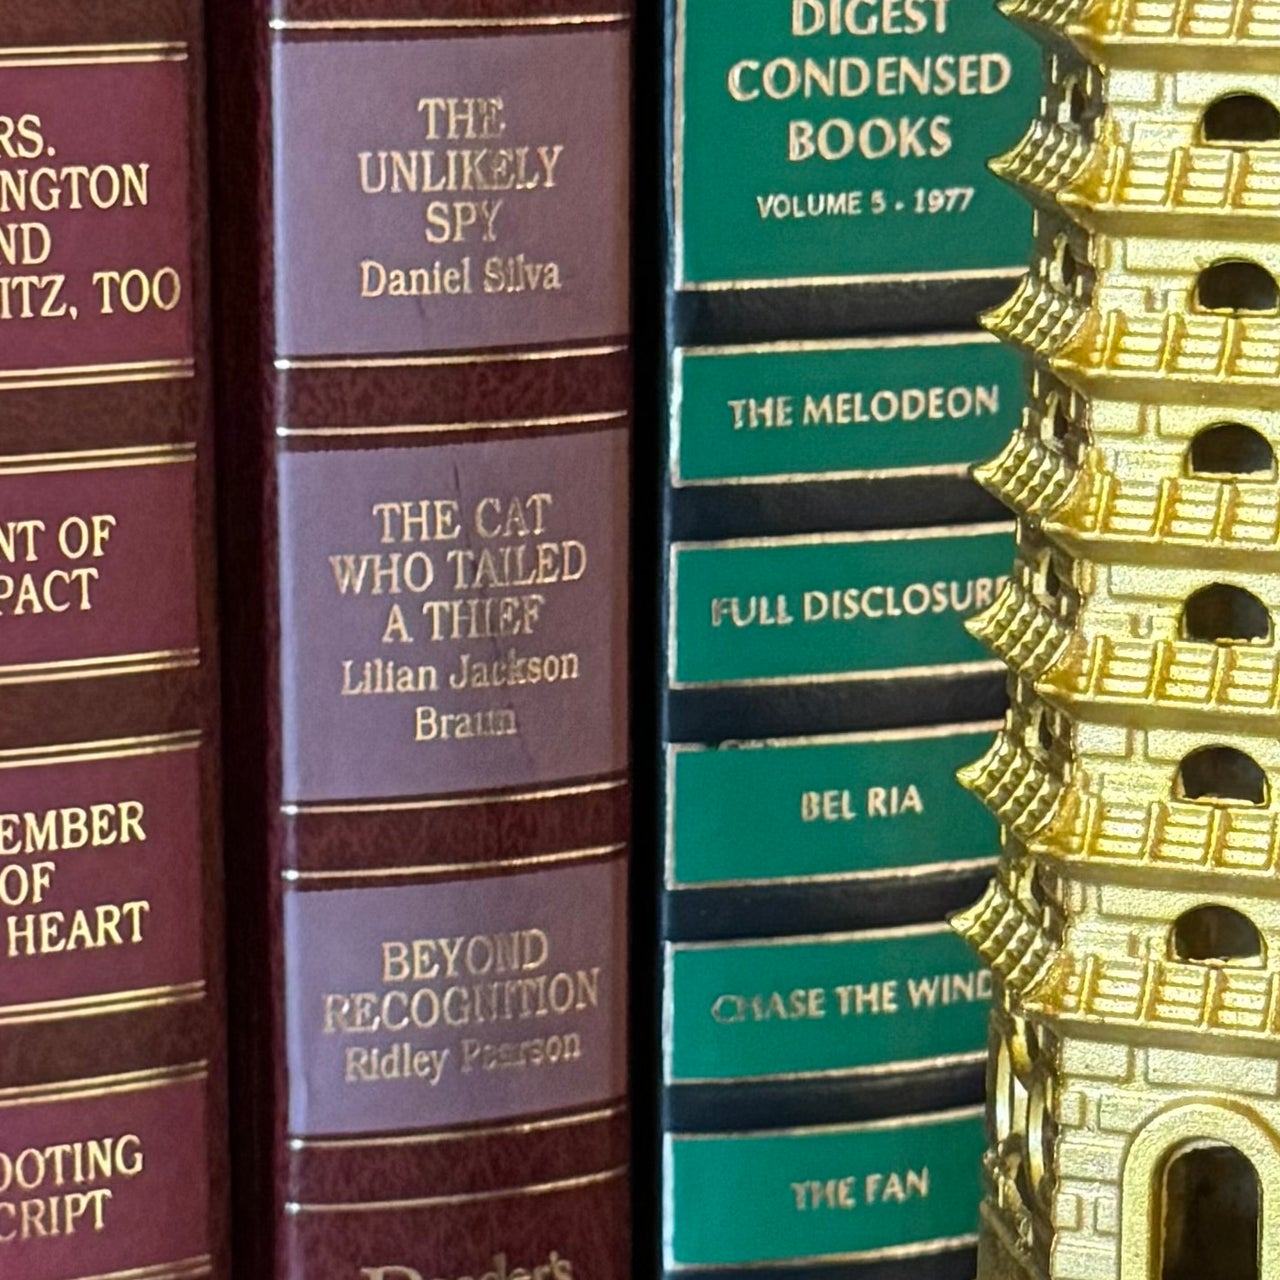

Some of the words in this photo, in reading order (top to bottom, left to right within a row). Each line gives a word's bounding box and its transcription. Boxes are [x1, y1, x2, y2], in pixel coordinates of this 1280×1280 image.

[727, 53, 1012, 102] CONDENSED
[418, 97, 505, 141] THE
[787, 115, 952, 161] BOOKS
[358, 145, 564, 195] UNLIKELY
[424, 200, 503, 244] SPY
[756, 191, 862, 219] VOLUME
[871, 191, 887, 212] 5
[914, 186, 975, 212] 1977
[92, 267, 181, 315] TOO
[361, 257, 472, 298] Daniel
[483, 255, 562, 294] Silva
[727, 395, 793, 431] THE
[802, 384, 1000, 425] MELODEON
[59, 514, 117, 559] OF
[373, 500, 459, 545] THE
[474, 493, 552, 538] CAT
[329, 551, 433, 596] WHO
[447, 540, 587, 590] TAILED
[382, 606, 413, 644] A
[423, 594, 545, 642] THIEF
[711, 595, 795, 627] FULL
[341, 657, 438, 697] Lilian
[449, 648, 579, 690] Jackson
[414, 704, 517, 744] Braun
[800, 789, 856, 822] BEL
[867, 784, 924, 816] RIA
[6, 901, 149, 959] HEART
[382, 929, 548, 983] BEYOND
[323, 966, 600, 1035] RECOGNITION
[710, 988, 825, 1023] CHASE
[834, 980, 898, 1016] THE
[906, 969, 992, 1007] WIND
[345, 1044, 448, 1086] Ridley
[790, 1175, 856, 1211] THE
[865, 1166, 929, 1203] FAN
